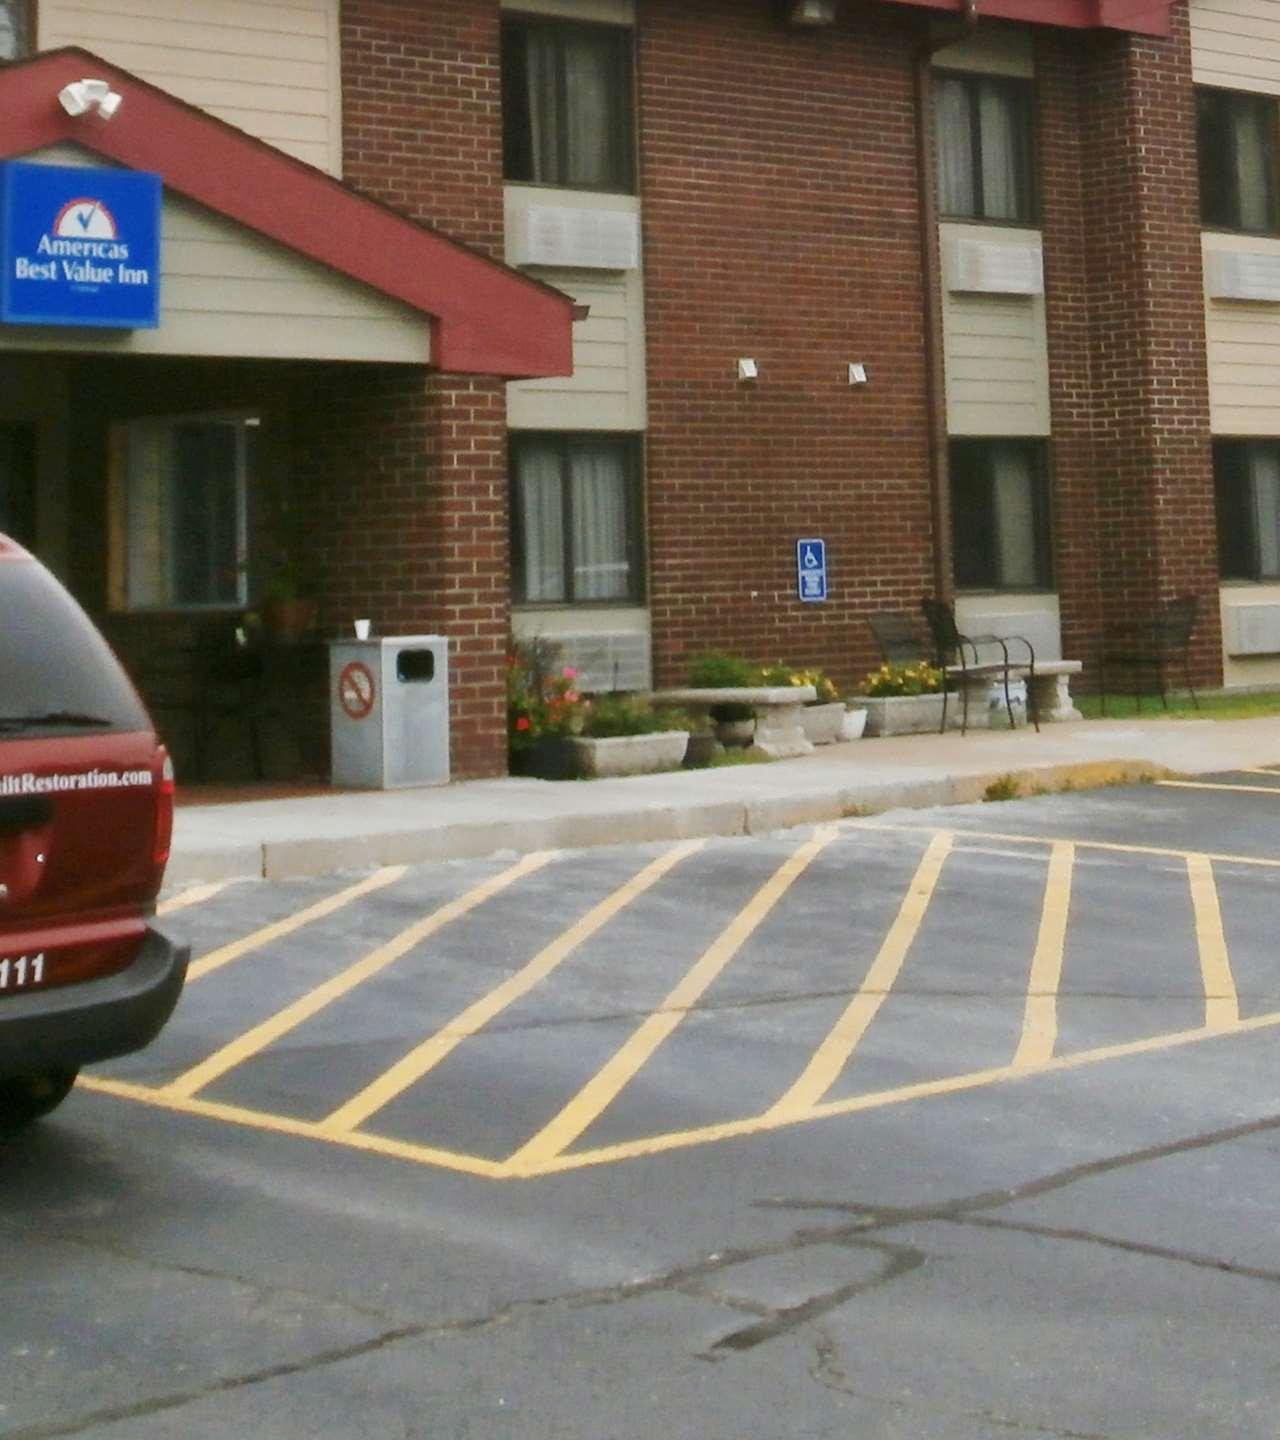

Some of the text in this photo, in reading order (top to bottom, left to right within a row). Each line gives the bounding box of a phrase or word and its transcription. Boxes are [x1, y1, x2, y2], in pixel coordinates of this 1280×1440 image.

[36, 233, 129, 260] Americas
[15, 257, 149, 285] Best Value Inn
